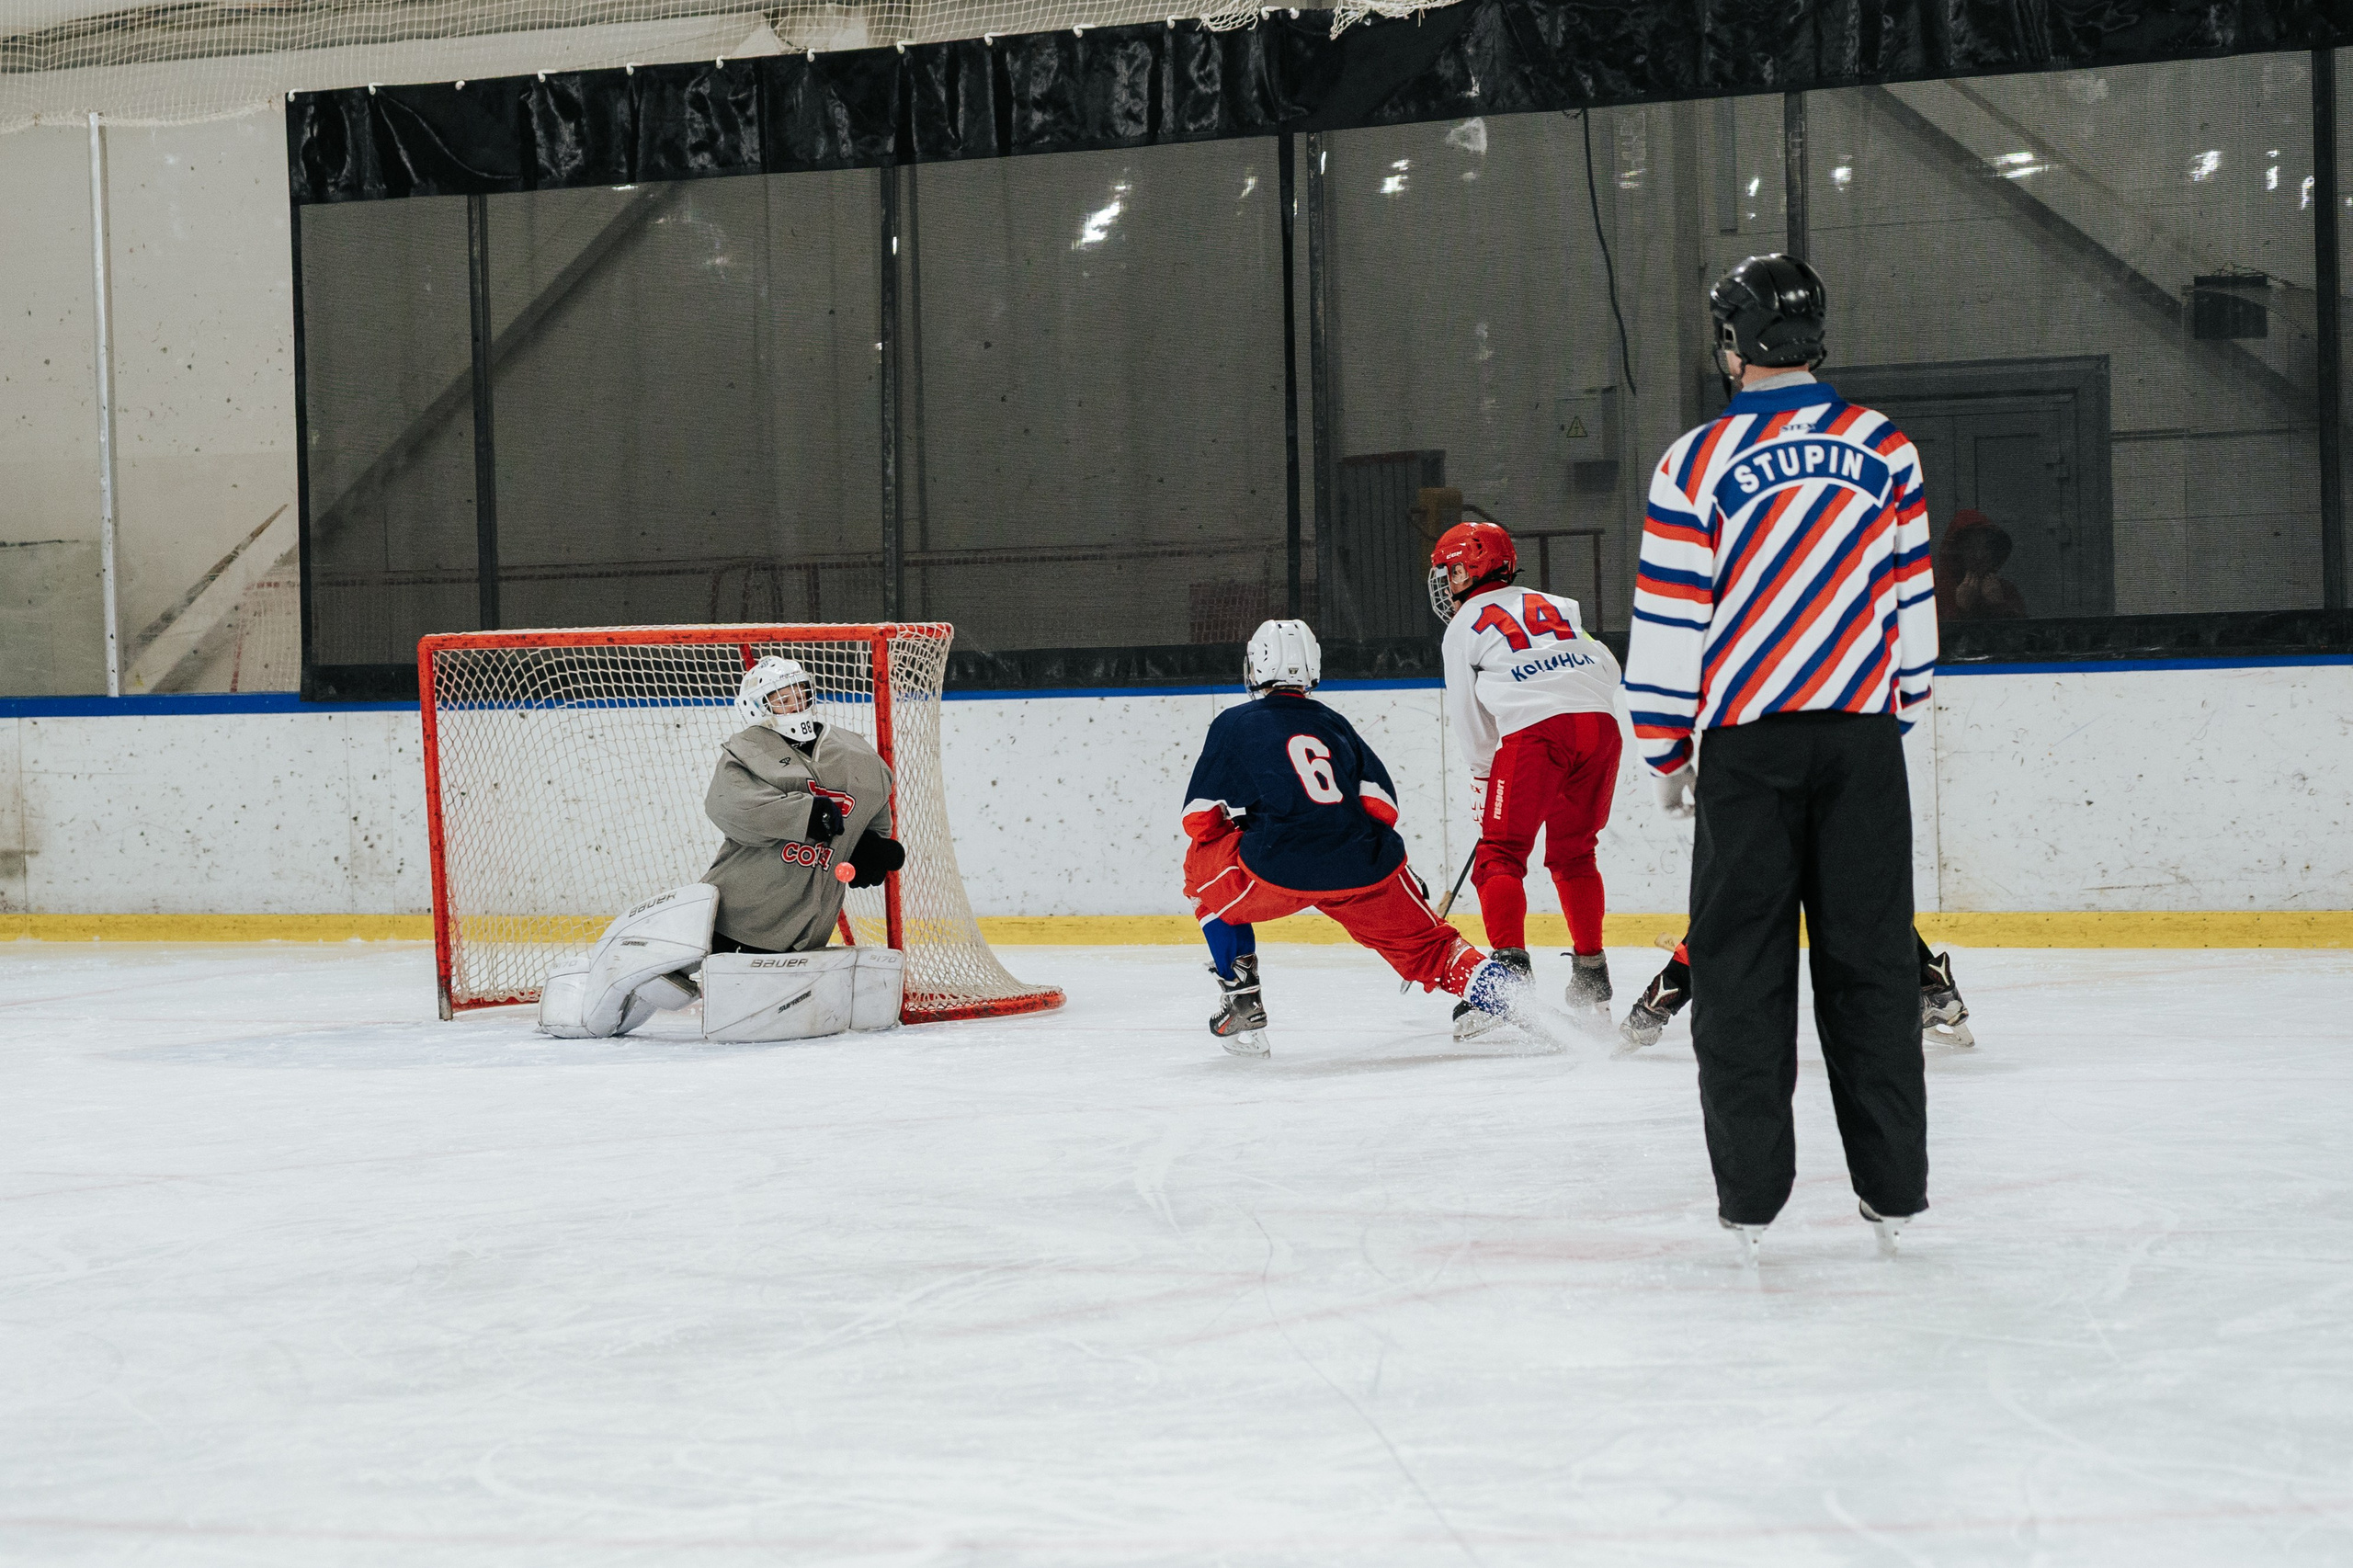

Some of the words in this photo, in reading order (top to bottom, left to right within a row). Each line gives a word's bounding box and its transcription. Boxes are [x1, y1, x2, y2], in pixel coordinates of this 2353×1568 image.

[1733, 445, 1864, 494] STUPIN
[1471, 593, 1577, 653] 14
[800, 721, 813, 734] 88
[1286, 733, 1345, 805] 6
[1493, 778, 1506, 820] rusport
[628, 890, 677, 918] BAUER
[750, 958, 809, 969] BAUER
